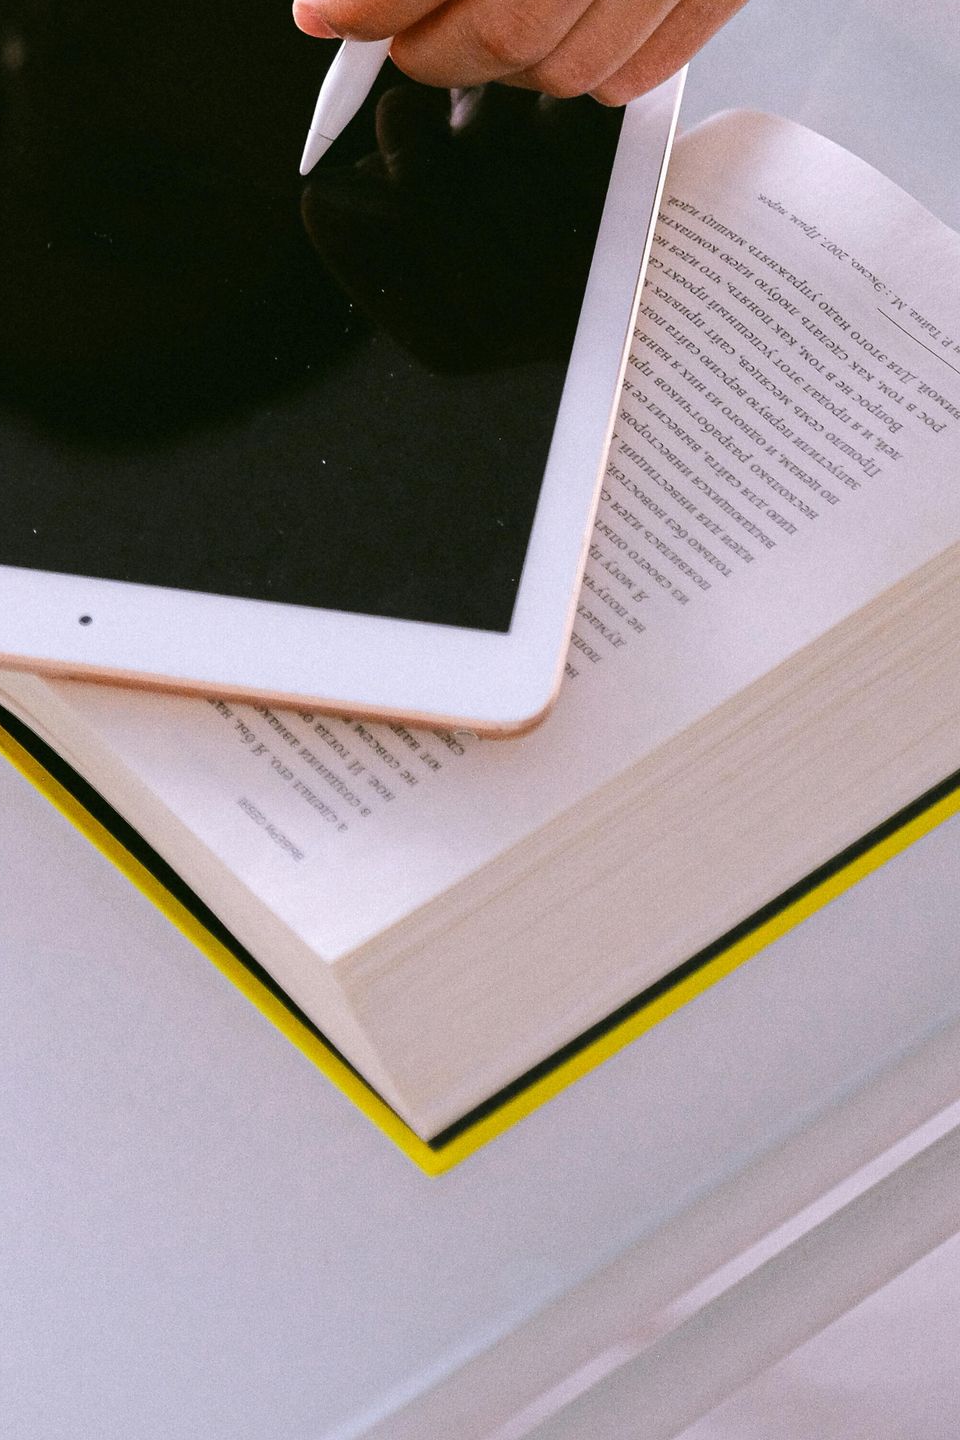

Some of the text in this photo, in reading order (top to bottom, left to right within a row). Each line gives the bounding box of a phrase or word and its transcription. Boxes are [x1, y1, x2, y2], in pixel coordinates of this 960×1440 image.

[667, 195, 700, 217] идей.
[756, 193, 787, 215] перев.
[697, 213, 747, 246] мышцу
[788, 214, 821, 240] Прим.
[667, 244, 700, 267] идея
[819, 237, 849, 261] 2007.
[697, 265, 722, 284] что
[717, 252, 754, 279] идею
[747, 244, 822, 302] упражнять
[850, 257, 886, 292] Эксмо,
[661, 267, 709, 301] проект
[753, 278, 799, 316] любую
[651, 286, 705, 328] привлек
[725, 281, 773, 325] понять,
[817, 301, 851, 331] надо
[889, 295, 907, 310] М.
[699, 299, 778, 358] успешный
[771, 323, 797, 347] как
[908, 308, 941, 340] Тайна.
[703, 328, 736, 355] сайт
[800, 316, 849, 360] сделать
[848, 330, 888, 362] этого
[939, 336, 953, 348] Р.
[668, 359, 682, 370] я
[772, 358, 804, 384] этот
[797, 344, 826, 373] том,
[847, 360, 875, 382] как
[885, 360, 917, 384] Для
[678, 368, 706, 392] них
[737, 354, 792, 405] месяцев,
[824, 371, 837, 381] в
[833, 380, 854, 395] не
[630, 389, 648, 404] ее
[639, 305, 860, 490] запустили первую версию сайта под
[703, 391, 723, 407] из
[801, 383, 851, 423] продал
[876, 379, 905, 404] том,
[653, 377, 753, 463] разработчиков
[792, 405, 825, 432] семь
[850, 393, 903, 434] Вопрос
[904, 402, 917, 412] в
[645, 402, 702, 452] вывесил
[720, 406, 766, 446] одного
[849, 421, 863, 431] я
[859, 428, 874, 440] и
[915, 411, 947, 433] рос
[763, 444, 778, 456] и
[823, 432, 881, 478] Прошло
[873, 436, 902, 461] лей,
[618, 408, 776, 549] выдающихся инвесторов.
[702, 450, 742, 488] сайта,
[777, 453, 822, 491] ценам,
[617, 440, 754, 563] идеи для инвестиций.
[739, 486, 769, 509] для
[748, 463, 818, 520] несколько
[818, 489, 840, 505] по
[604, 460, 732, 577] только без новостей,
[609, 501, 644, 531] идея
[764, 508, 798, 535] цию
[626, 549, 672, 589] своего
[643, 530, 711, 591] появилась
[600, 560, 635, 590] могу
[630, 589, 649, 603] Я
[670, 588, 690, 605] из
[625, 616, 646, 634] не
[234, 718, 255, 743] бы,
[313, 723, 350, 758] тогда
[250, 742, 269, 756] Я
[353, 724, 418, 786] не совсем
[269, 755, 294, 780] его.
[297, 747, 361, 806] создании
[292, 780, 338, 822] сделал
[359, 806, 371, 817] в
[336, 822, 348, 832] а
